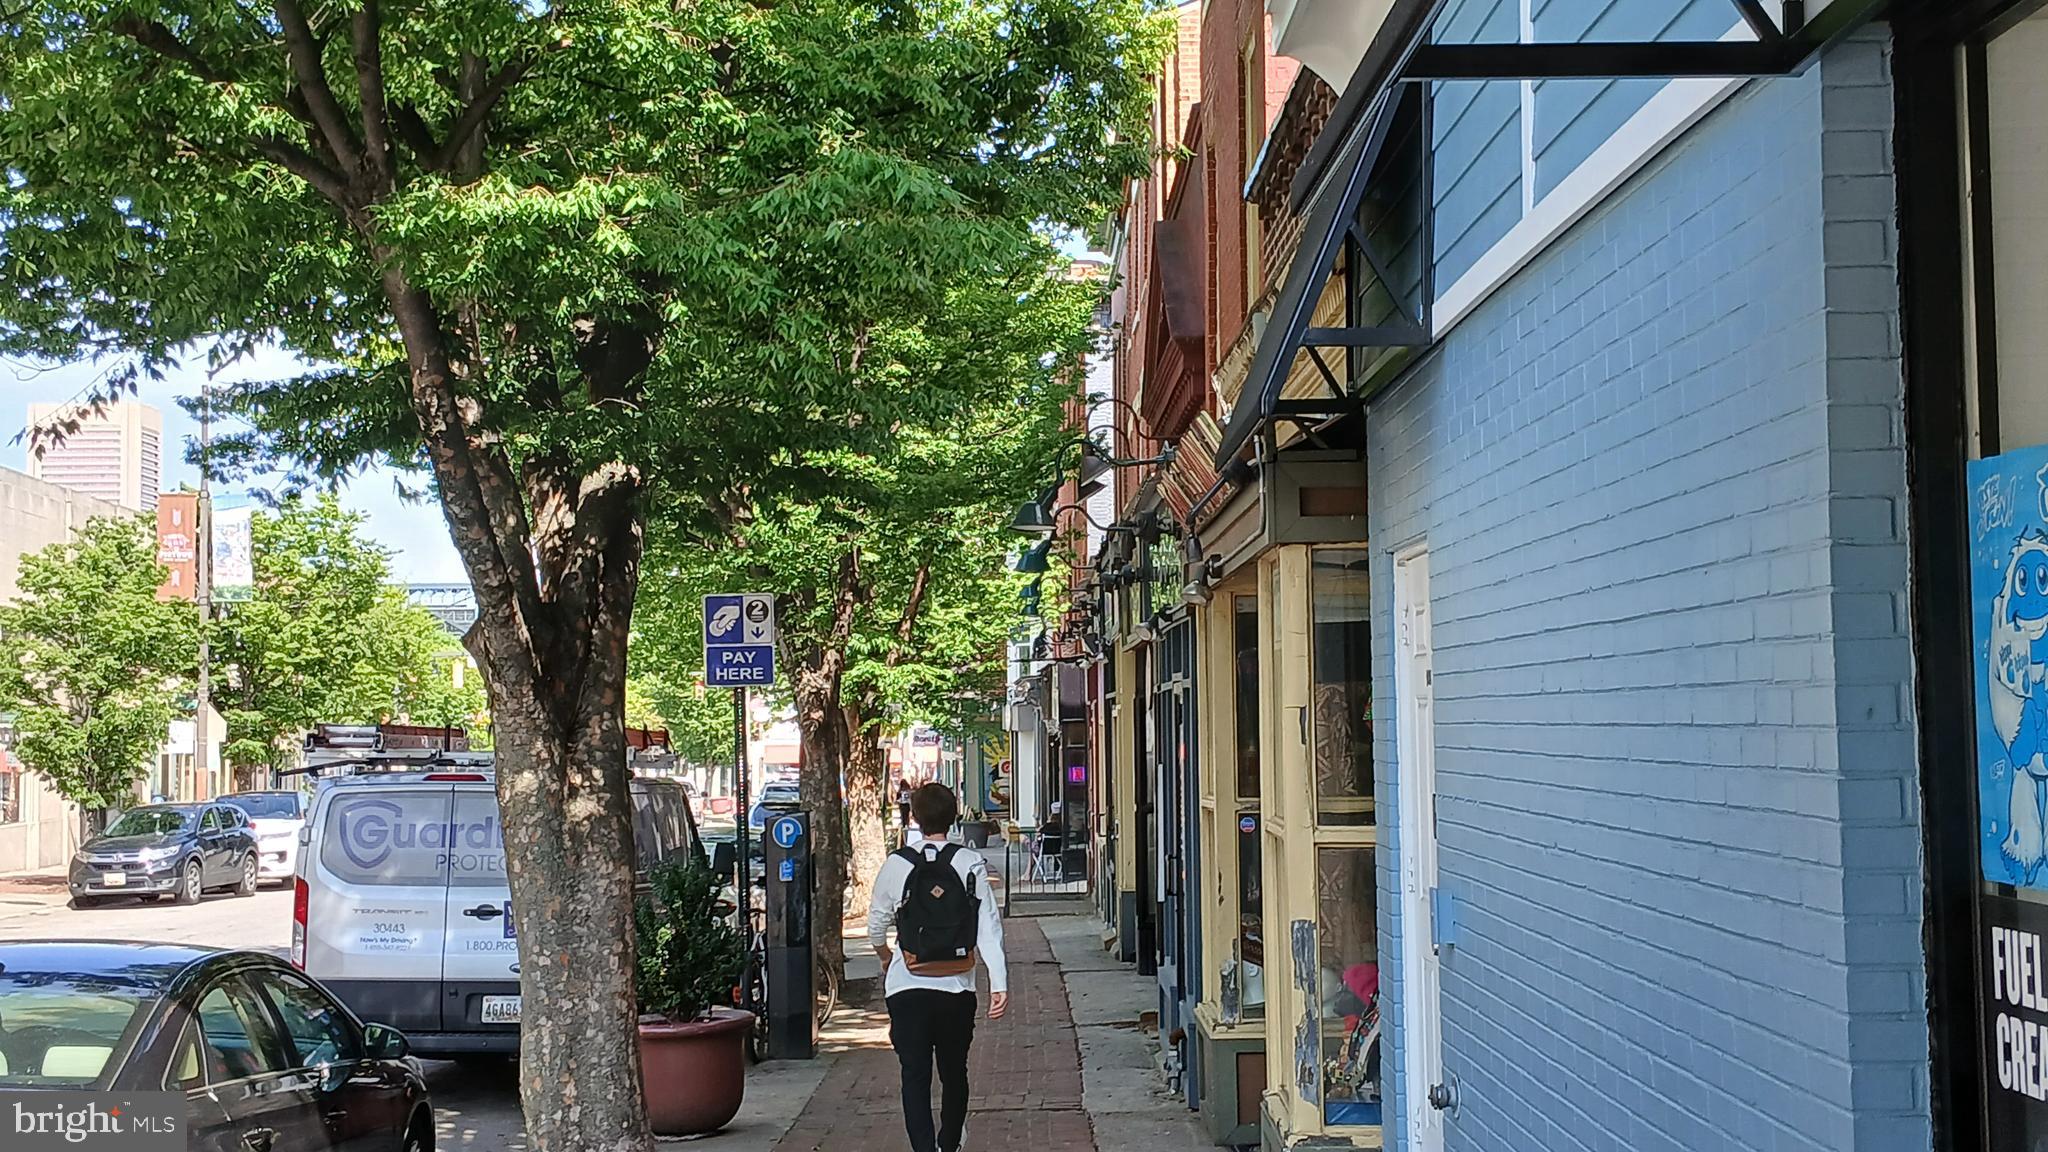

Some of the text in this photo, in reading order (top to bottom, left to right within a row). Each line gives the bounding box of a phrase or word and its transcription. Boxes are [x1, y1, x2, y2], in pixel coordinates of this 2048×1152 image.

[751, 601, 763, 615] 2
[722, 651, 756, 664] PAY
[715, 667, 764, 680] HERE
[782, 823, 794, 843] P
[373, 923, 405, 934] 30443
[1992, 926, 2048, 1013] FUEL
[485, 1003, 521, 1017] 4GA86
